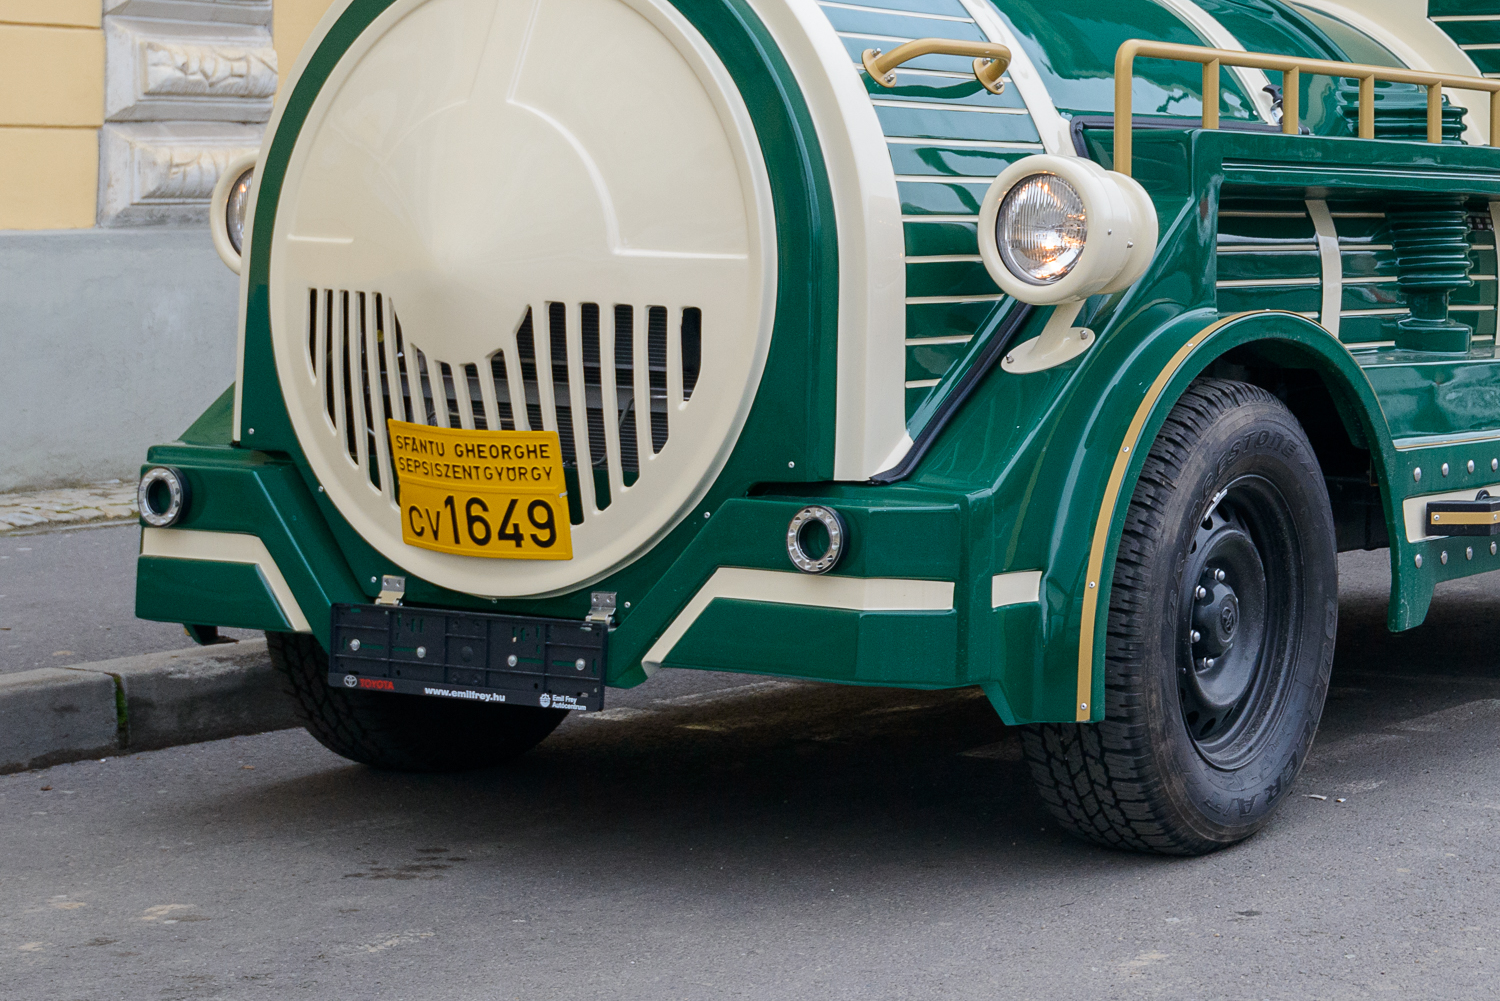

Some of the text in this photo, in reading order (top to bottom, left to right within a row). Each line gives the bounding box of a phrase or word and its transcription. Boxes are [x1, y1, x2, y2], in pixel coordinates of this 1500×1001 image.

[454, 443, 551, 460] GHEORGHE
[398, 456, 553, 481] SEPSISZENTGYÖRGY
[359, 678, 395, 690] TOYOTA
[424, 687, 506, 702] www.emilfrey.hu
[552, 694, 578, 705] Emil Frey
